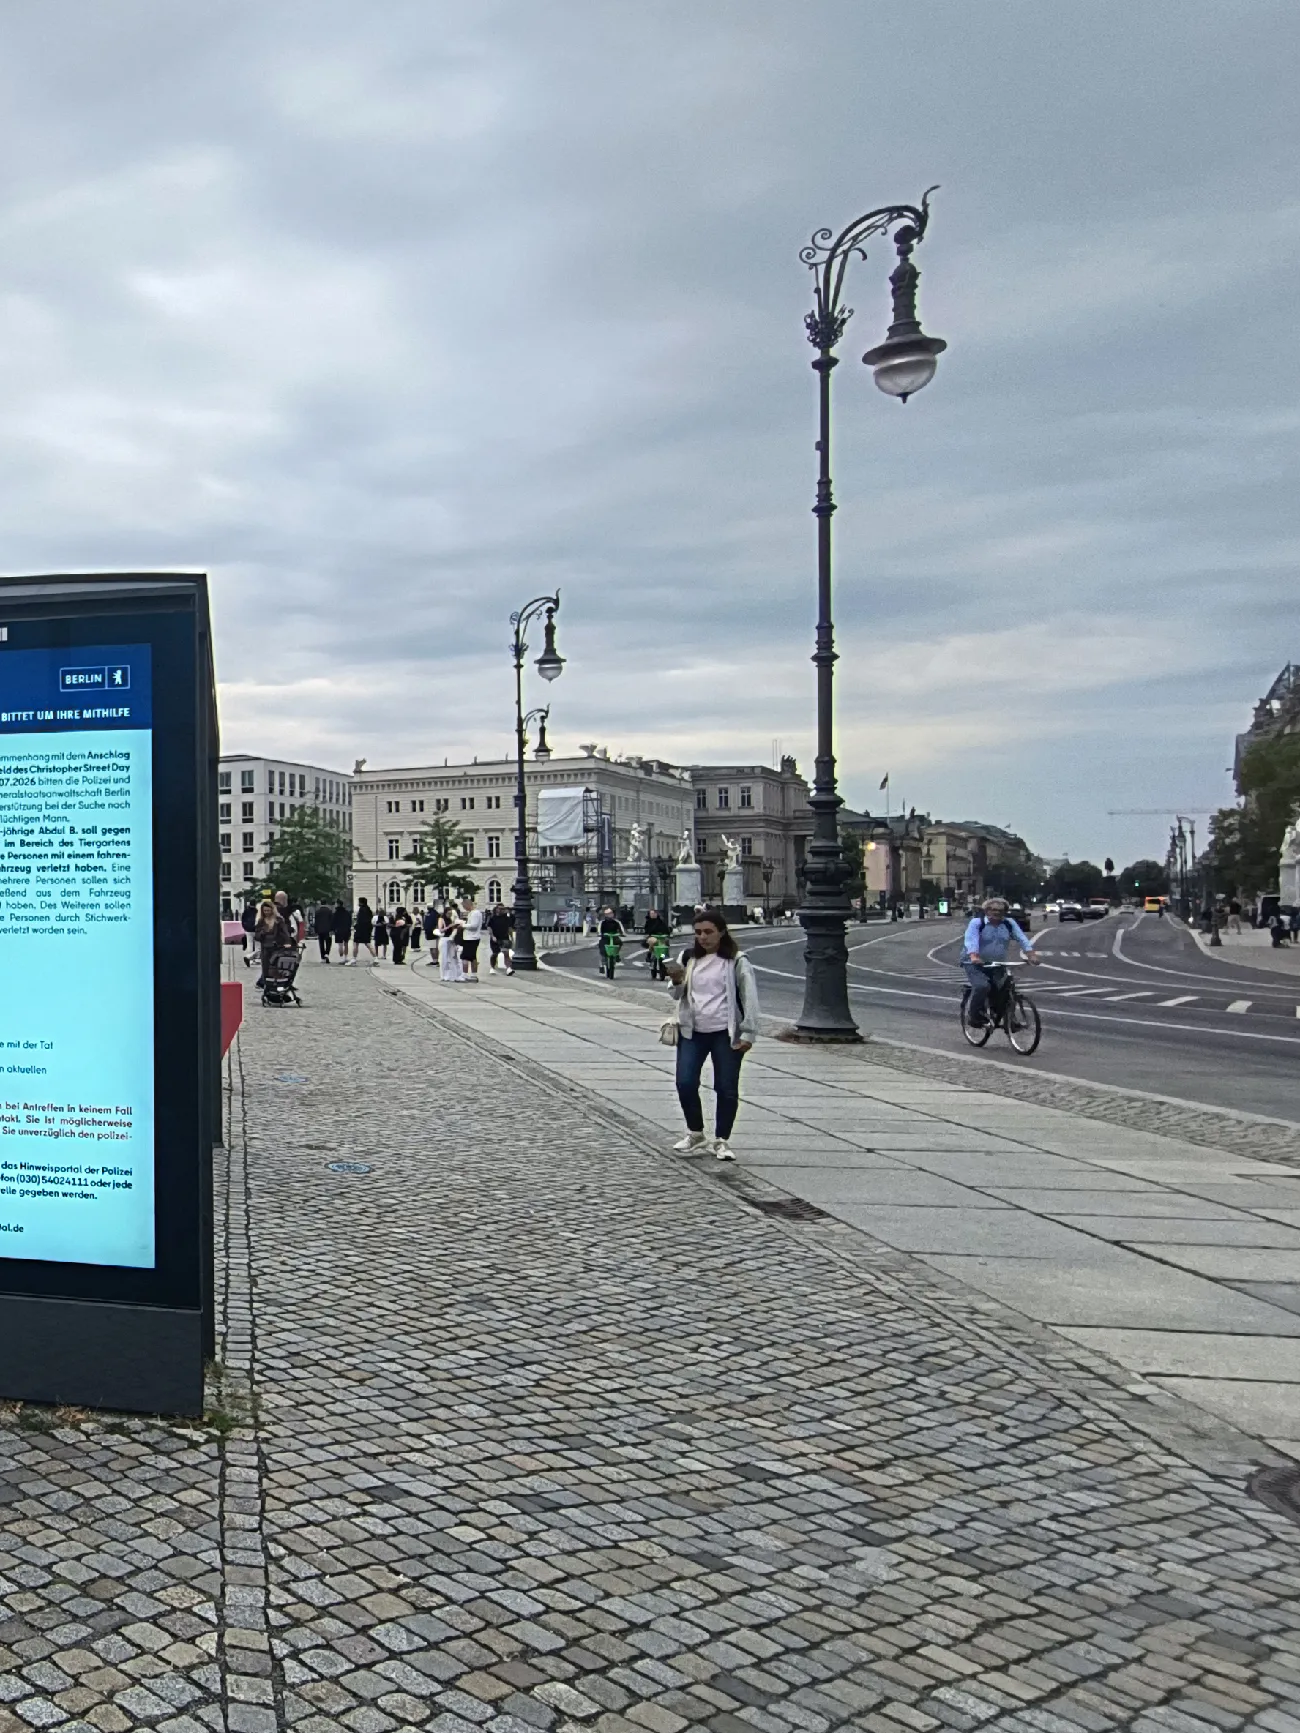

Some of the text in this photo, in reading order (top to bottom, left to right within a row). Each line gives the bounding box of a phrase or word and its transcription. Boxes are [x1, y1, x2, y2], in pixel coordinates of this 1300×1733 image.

[65, 673, 102, 685] BERLIN
[37, 710, 54, 721] UM
[56, 709, 80, 720] IHRE
[83, 707, 130, 719] MITHILFE
[50, 751, 64, 760] mit
[65, 751, 86, 760] dem
[86, 749, 130, 761] Anschlag
[12, 765, 28, 774] des
[28, 763, 83, 775] Christopher
[82, 763, 110, 771] Street
[111, 762, 130, 773] Day
[37, 775, 63, 785] bitten
[64, 776, 80, 785] die
[81, 774, 111, 785] Polizei
[112, 774, 130, 784] und
[104, 787, 130, 796] Berlin
[44, 800, 59, 810] bei
[60, 800, 76, 809] der
[77, 800, 105, 809] Suche
[107, 800, 131, 809] nach
[37, 825, 66, 834] Abdul
[68, 825, 79, 834] B.
[80, 825, 98, 834] soll
[100, 827, 131, 836] gegen
[3, 838, 15, 847] im
[19, 838, 54, 847] Bereich
[58, 838, 74, 847] des
[7, 850, 49, 860] Personen
[50, 850, 64, 859] mit
[66, 850, 95, 859] einem
[35, 863, 71, 872] verletzt
[74, 863, 107, 872] haben.
[111, 862, 132, 872] Eine
[35, 875, 76, 884] Personen
[81, 875, 108, 884] sollen
[112, 875, 131, 884] sich
[59, 887, 80, 897] dem
[88, 887, 131, 899] Fahrzeug
[5, 900, 36, 909] haben.
[39, 900, 57, 909] Des
[60, 901, 100, 909] Weiteren
[104, 901, 131, 909] sollen
[9, 912, 51, 921] Personen
[54, 912, 80, 922] durch
[31, 925, 64, 934] worden
[66, 927, 87, 935] sein.
[25, 1114, 40, 1124] Sie
[0, 1160, 18, 1170] das
[19, 1161, 83, 1175] Hinweisportal
[83, 1165, 100, 1174] der
[101, 1165, 133, 1176] Polizei
[15, 1173, 41, 1186] (030)
[89, 1177, 111, 1188] oder
[111, 1178, 133, 1191] jede
[18, 1187, 60, 1199] gegeben
[60, 1189, 97, 1200] werden.
